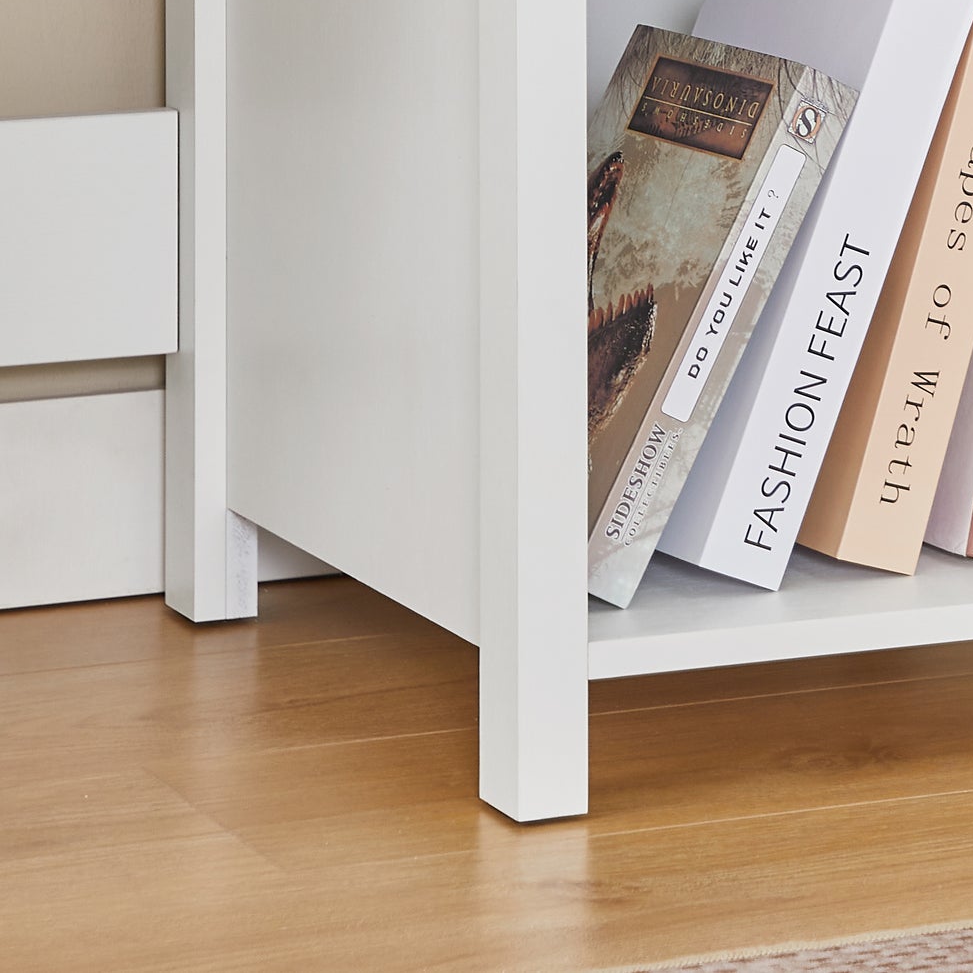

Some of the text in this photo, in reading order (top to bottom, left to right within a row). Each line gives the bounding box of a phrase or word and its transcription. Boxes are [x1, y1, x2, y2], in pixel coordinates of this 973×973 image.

[651, 76, 760, 119] DINOSAURIA
[688, 346, 708, 379] DO
[705, 291, 733, 335] YOU
[729, 236, 759, 287] LIKE
[755, 207, 771, 230] IT
[926, 283, 952, 341] of
[743, 233, 870, 551] FASHION FEAST
[880, 370, 940, 504] Wrath
[605, 423, 667, 541] SIDESHOW
